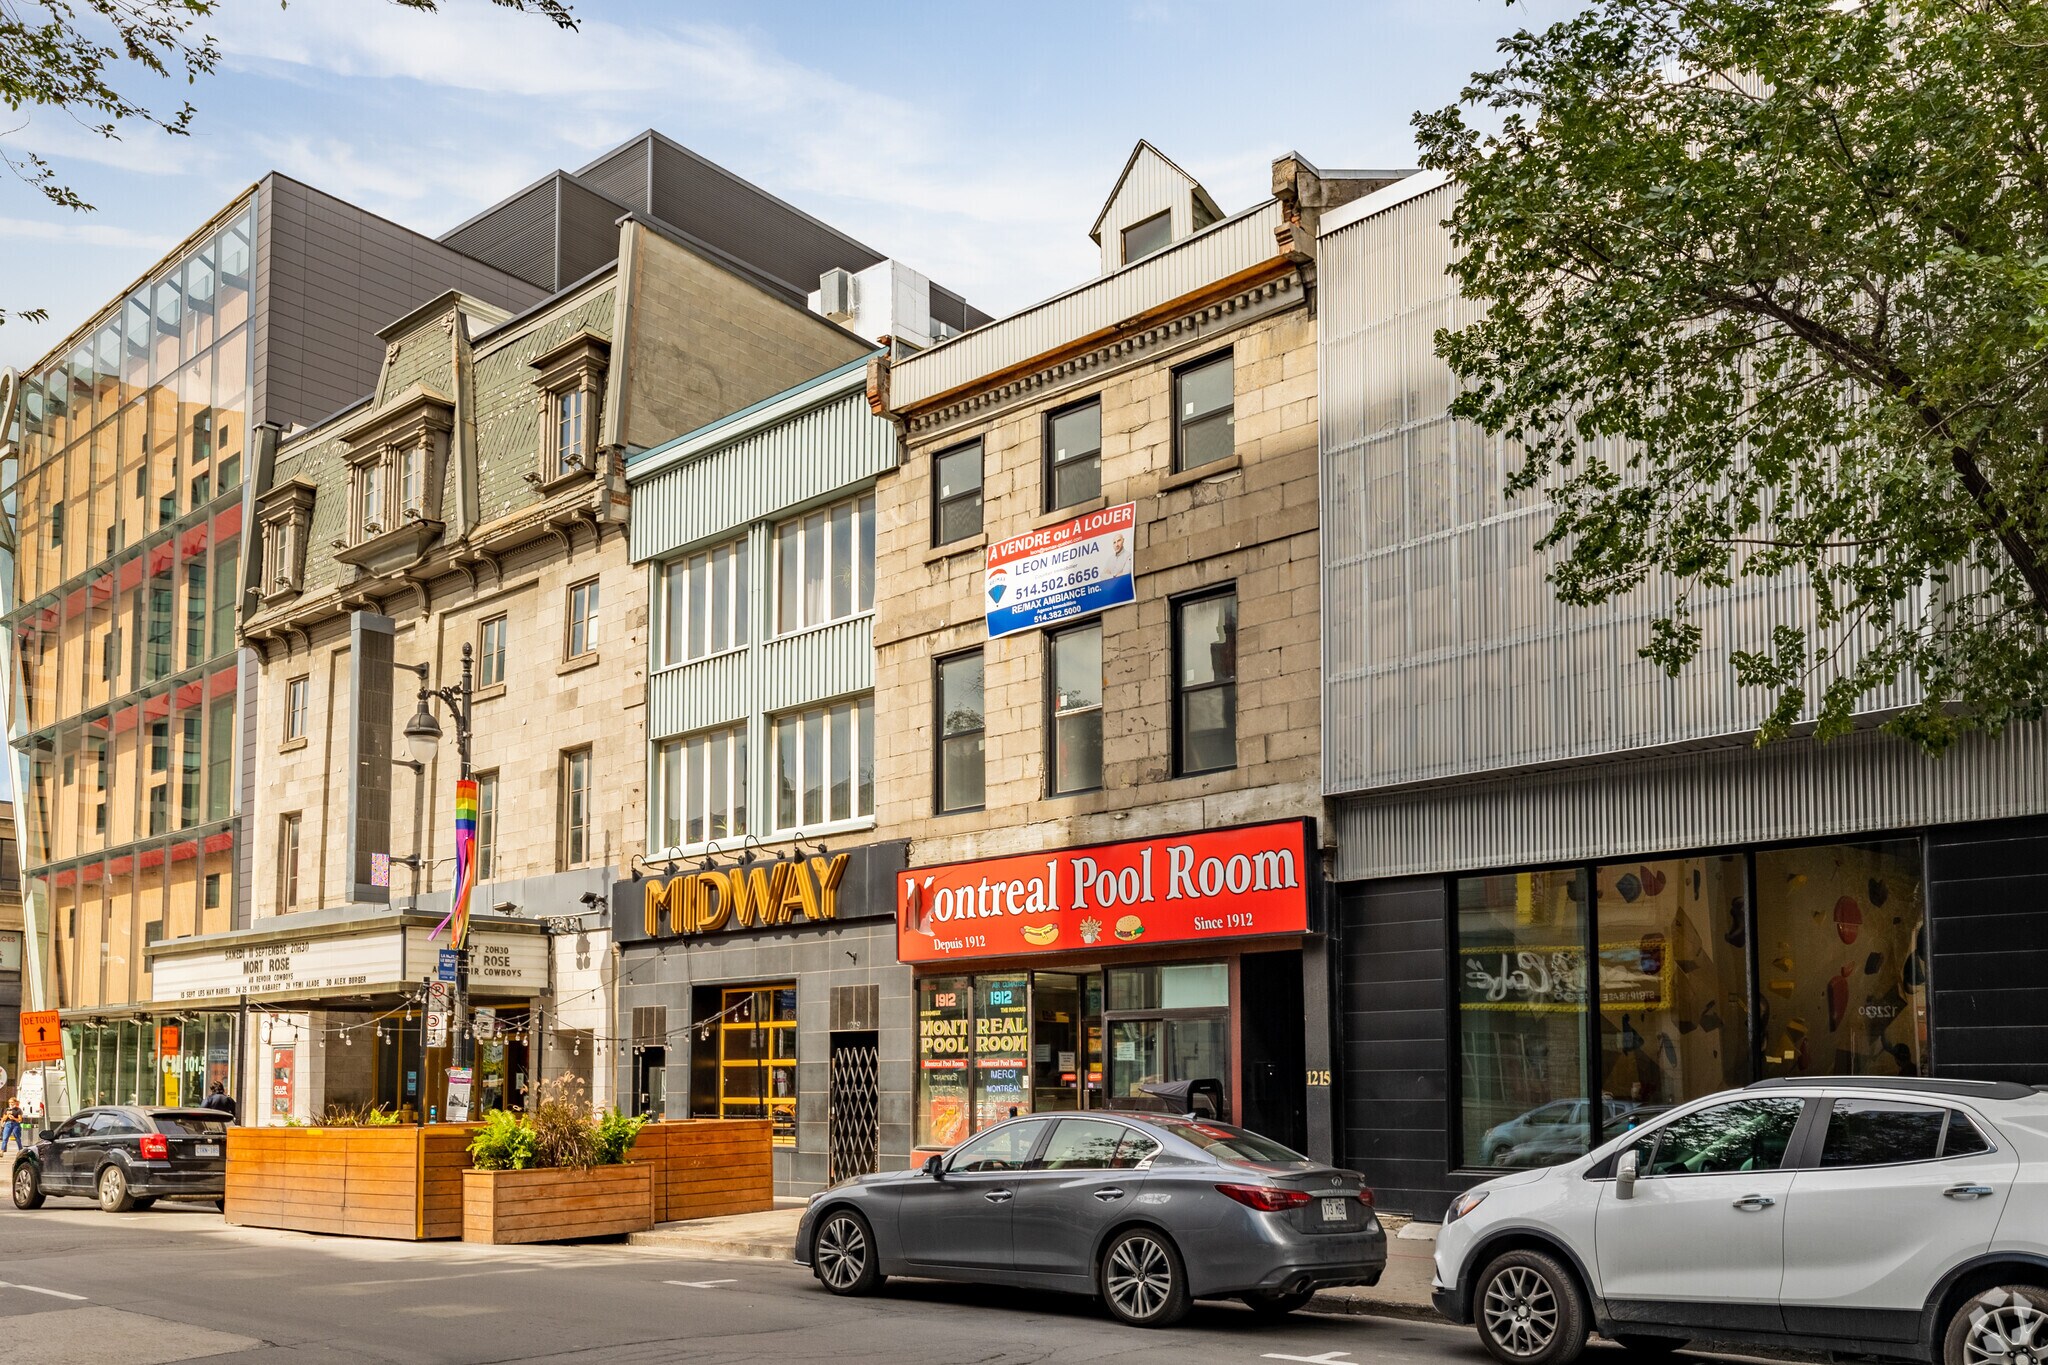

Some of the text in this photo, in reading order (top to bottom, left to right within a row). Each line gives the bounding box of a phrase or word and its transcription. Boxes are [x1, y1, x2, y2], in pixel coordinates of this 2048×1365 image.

[989, 507, 1132, 562] À VENDRE ou À LOUER
[1015, 541, 1100, 577] LEON MEDINA
[1015, 566, 1099, 600] 514.502.6656
[1011, 585, 1102, 615] RE/MAX AMBIANCE inc.
[1033, 605, 1082, 624] 514.382.5000
[1070, 846, 1155, 910] Pool
[1165, 844, 1299, 901] Room
[644, 853, 850, 937] MIDWAY
[1193, 912, 1254, 931] Since 1912
[225, 946, 246, 961] SAMEDI
[255, 943, 287, 958] SEPTEMBRE
[290, 941, 310, 954] 20H30
[485, 945, 509, 955] 20H30
[933, 935, 986, 952] Depuis 1912
[243, 957, 291, 974] MORT ROSE
[483, 955, 511, 967] ROSE
[273, 972, 294, 982] COWBOYS
[334, 976, 347, 986] ALEX
[484, 968, 522, 978] COWBOYS
[935, 993, 956, 1007] 1912
[990, 991, 1012, 1005] 1912
[920, 1017, 1028, 1036] MONT REAL
[920, 1035, 1028, 1053] POOL ROOM
[990, 1069, 1016, 1079] MERCI
[1306, 1070, 1331, 1086] 1215
[986, 1083, 1021, 1093] MONTRÉAL
